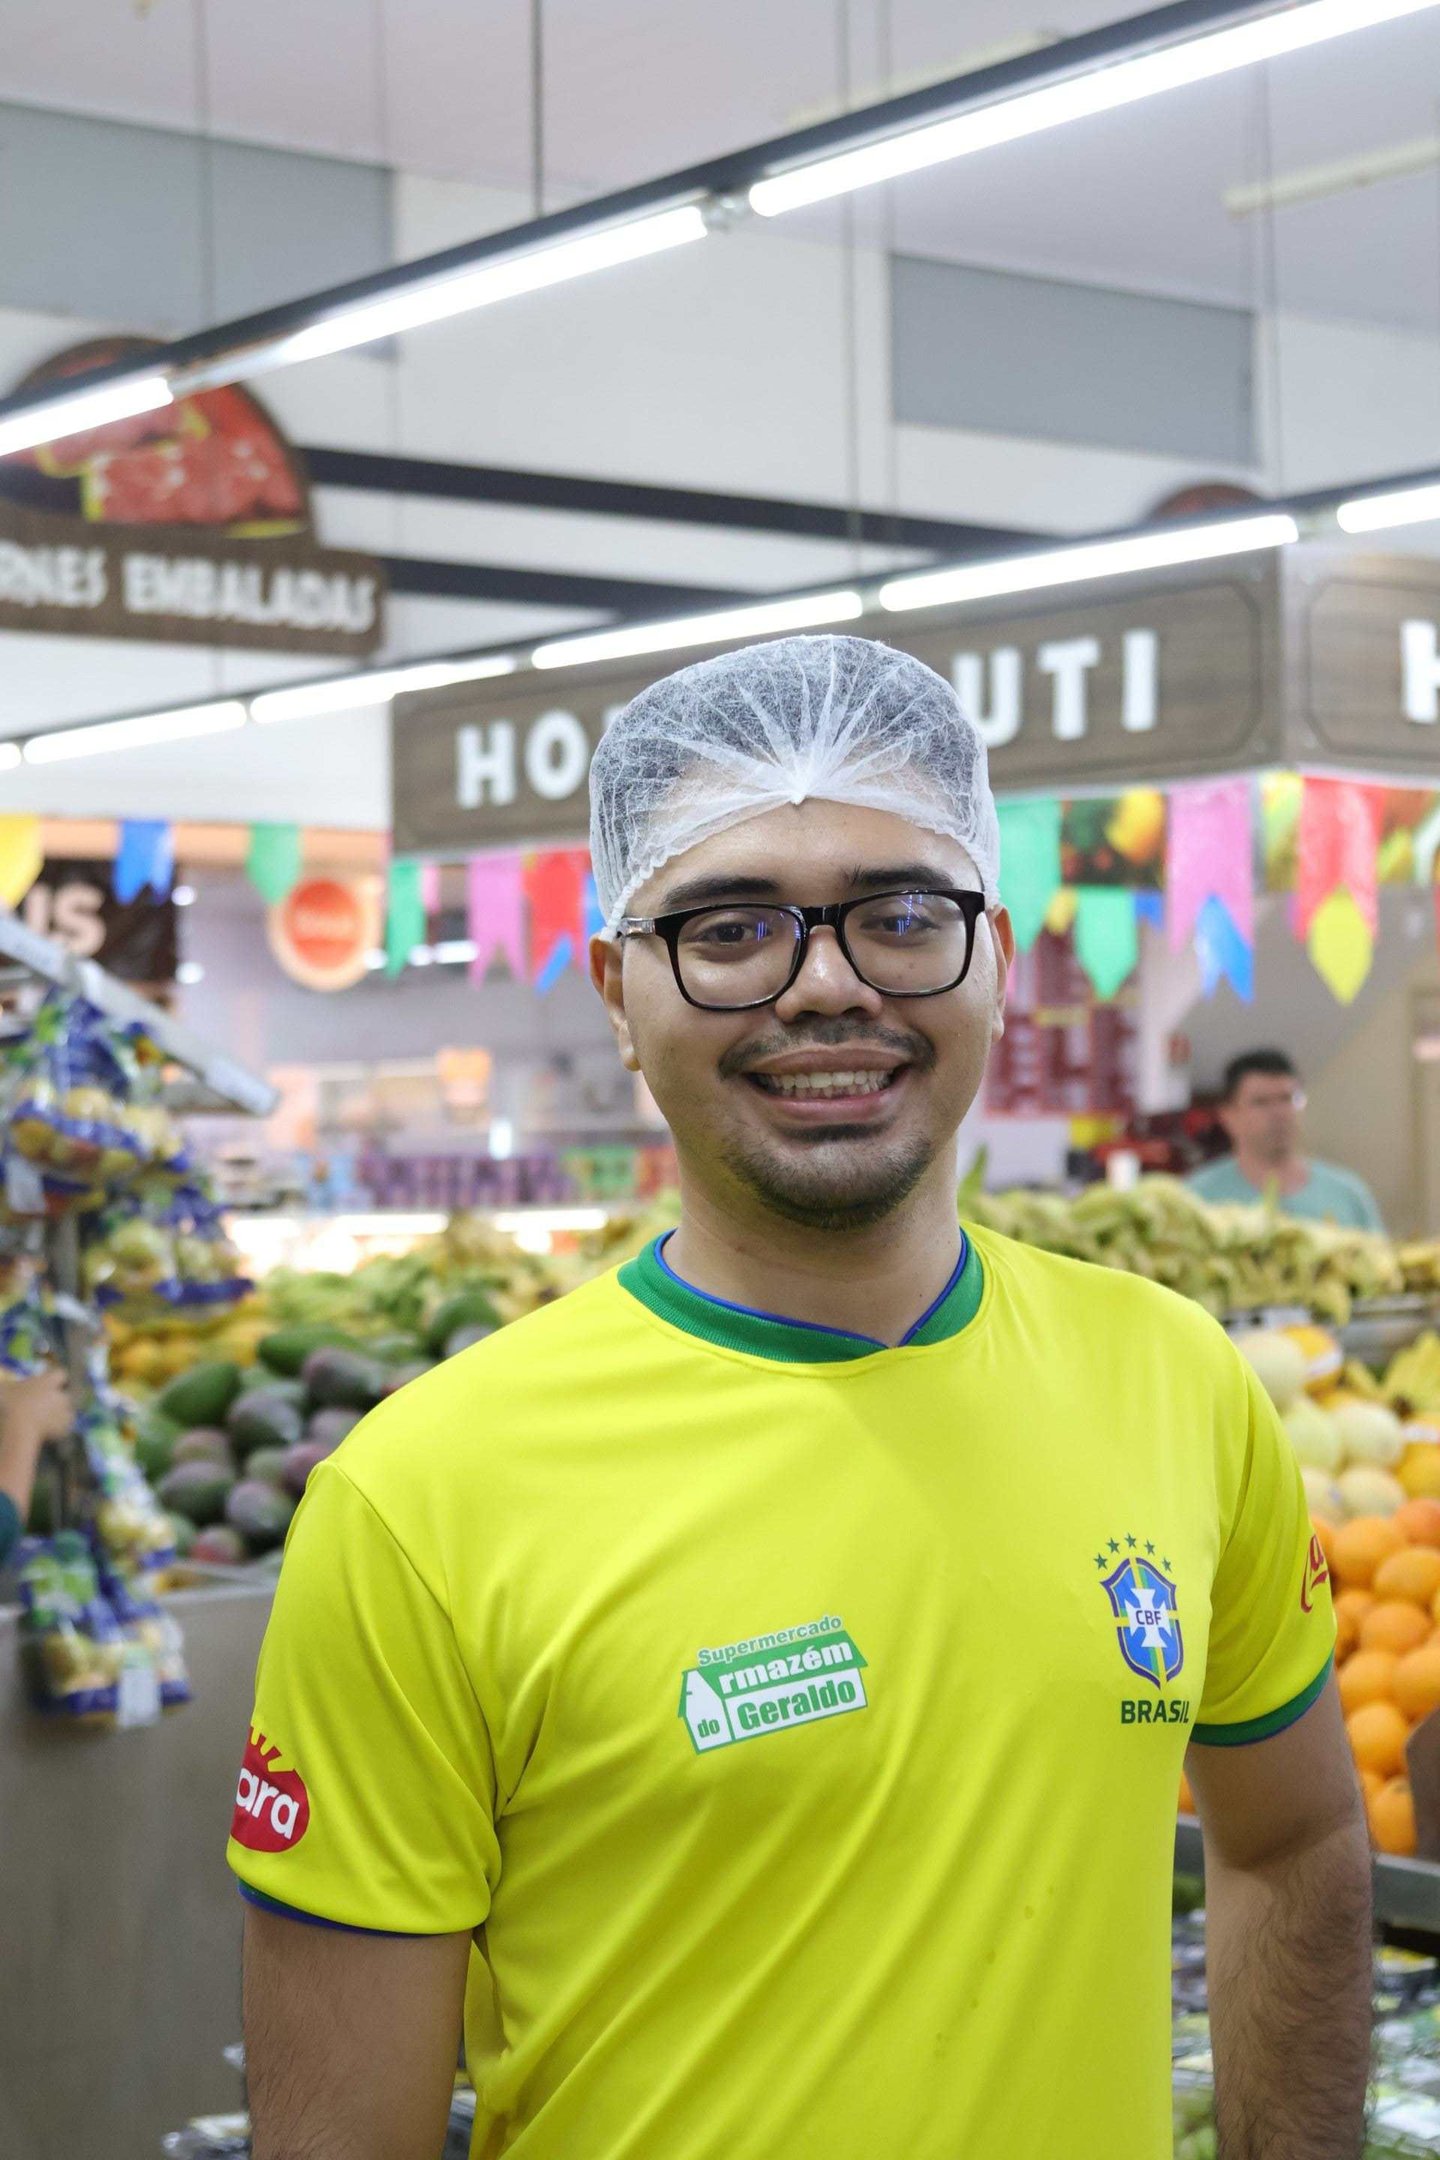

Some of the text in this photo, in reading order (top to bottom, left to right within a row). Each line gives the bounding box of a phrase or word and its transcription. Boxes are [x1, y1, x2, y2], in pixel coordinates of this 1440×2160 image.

[122, 551, 376, 634] EMBALADAS
[697, 1615, 842, 1666] Supermercado
[1135, 1609, 1162, 1626] CBF
[697, 1679, 857, 1739] do Geraldo
[1120, 1699, 1190, 1725] BRASIL
